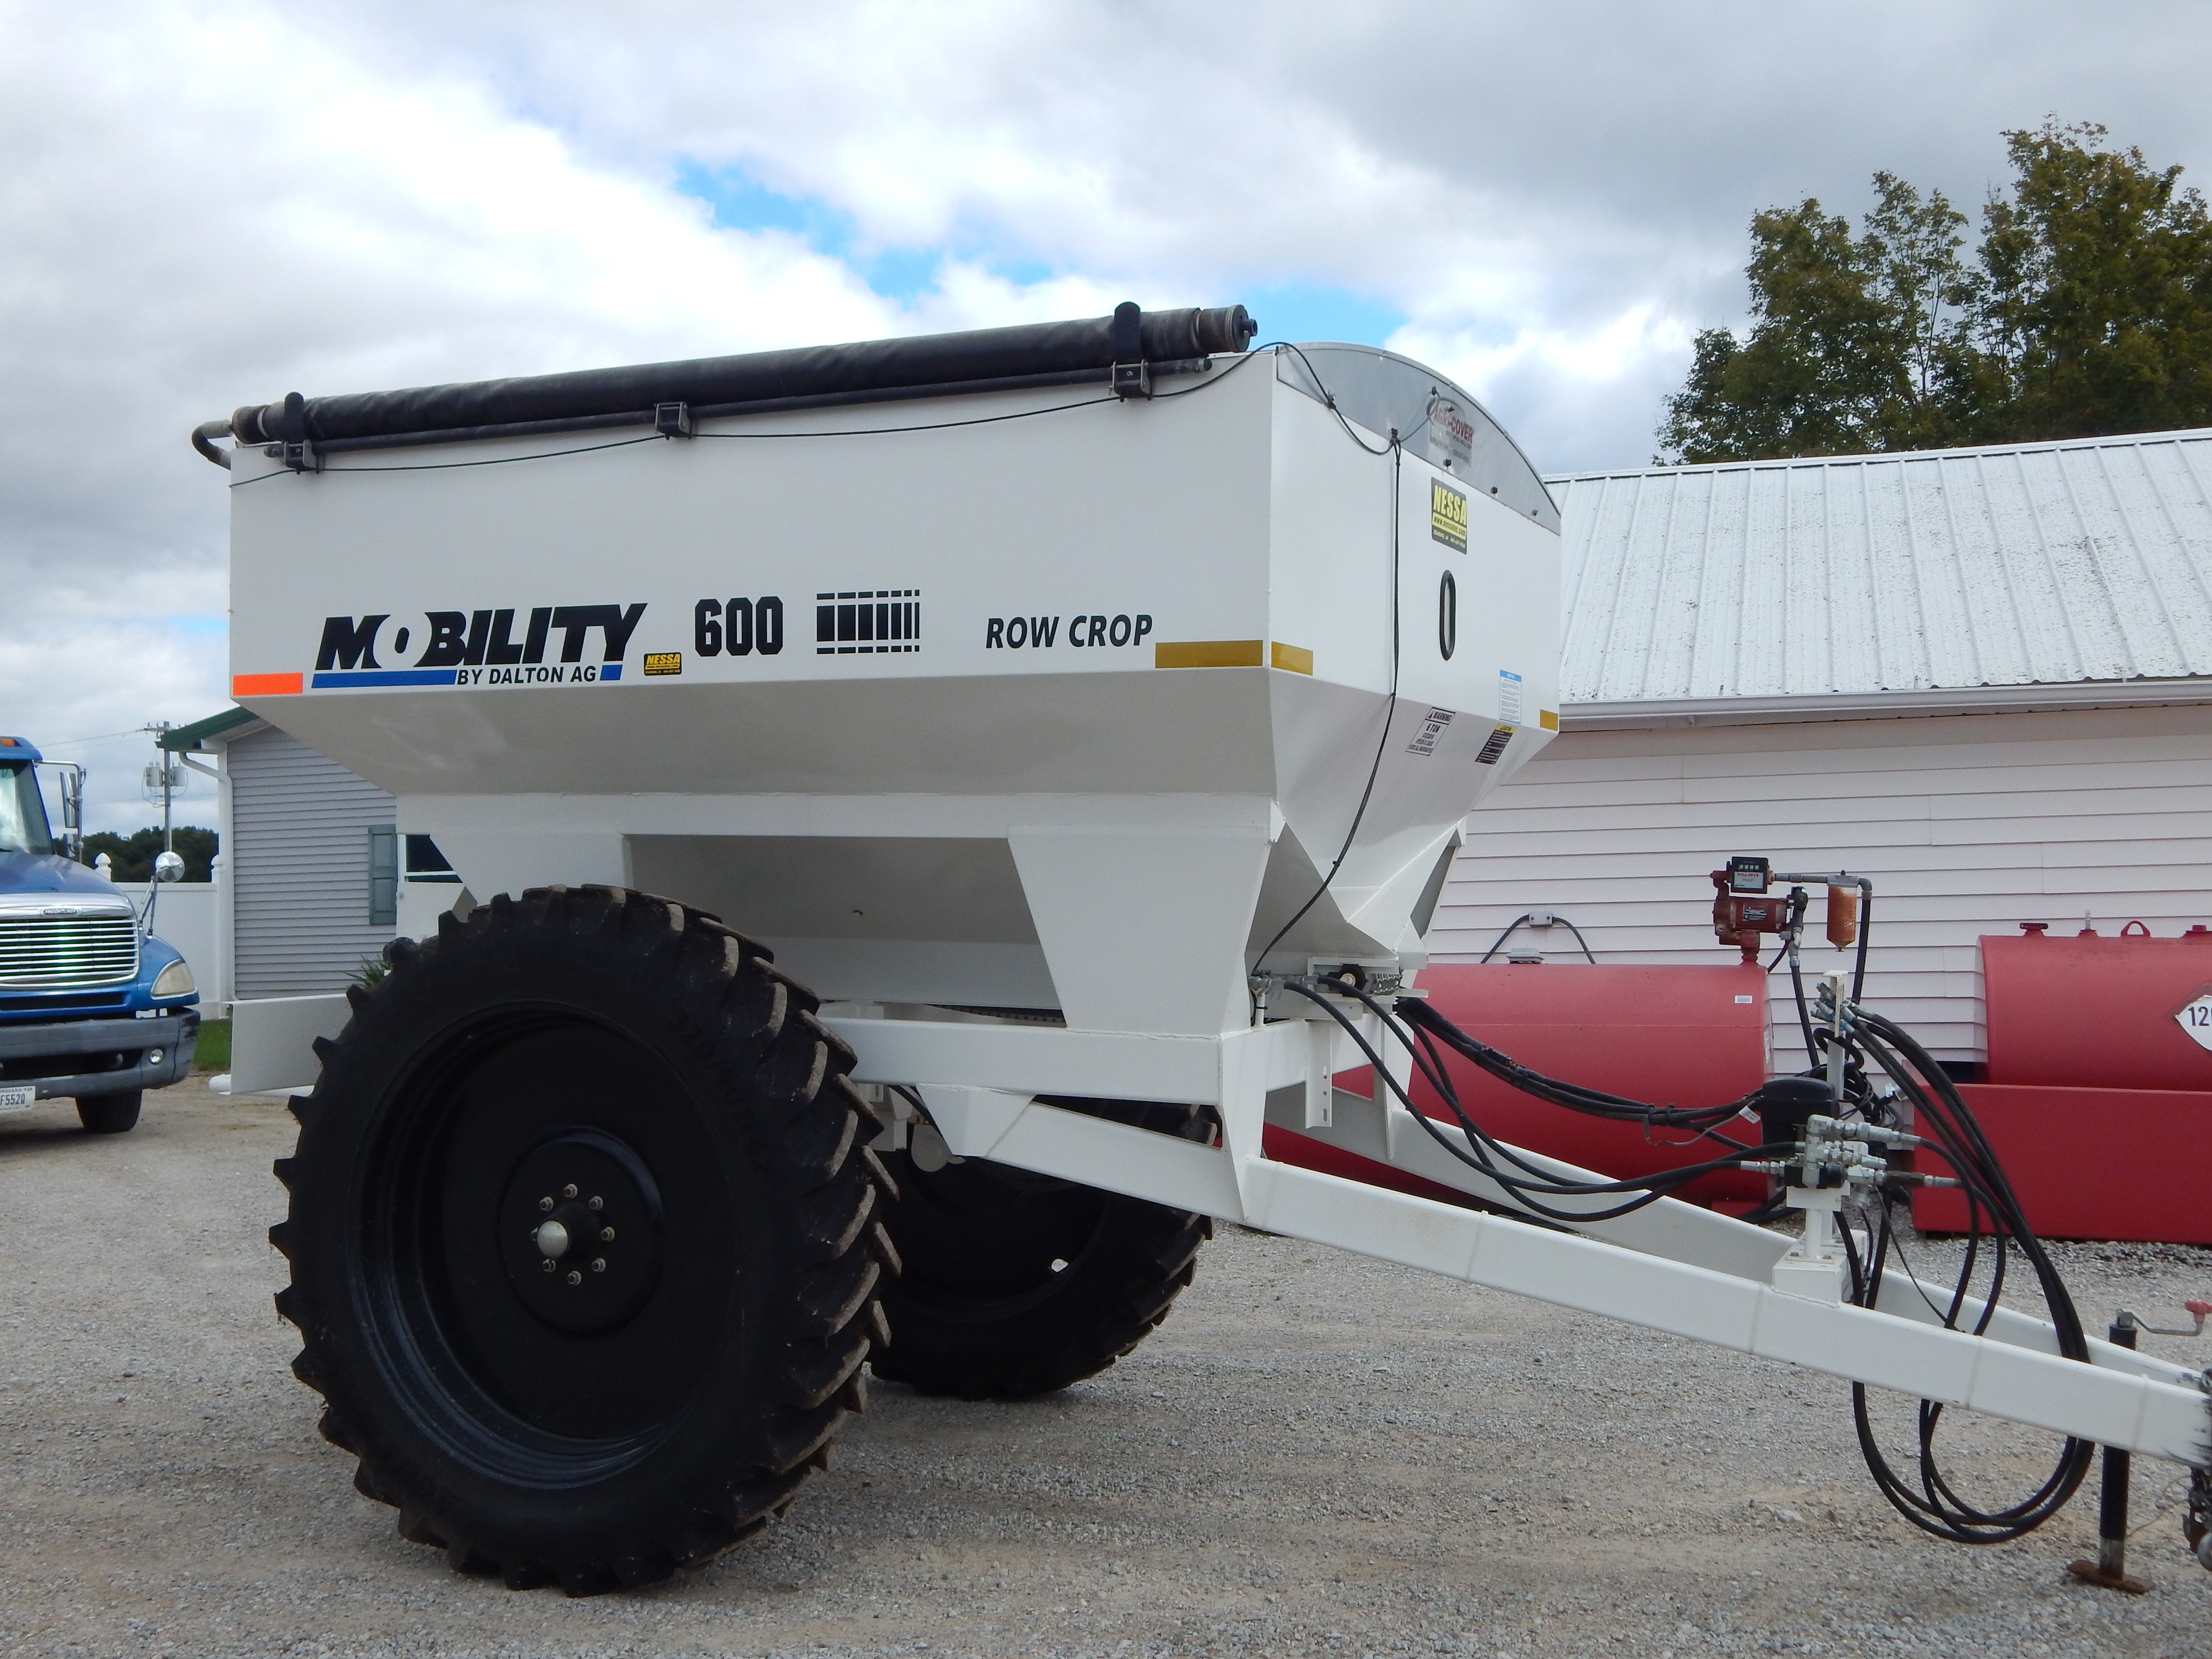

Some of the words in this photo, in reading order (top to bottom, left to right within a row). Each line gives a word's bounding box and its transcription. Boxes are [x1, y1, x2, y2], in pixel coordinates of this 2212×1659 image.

[1433, 485, 1467, 525] NESSA
[315, 603, 648, 670] MOBILITY
[695, 596, 783, 657] 600
[986, 616, 1059, 648] ROW
[1068, 614, 1153, 647] CROP
[457, 669, 483, 685] BY
[489, 667, 564, 684] DALTON
[570, 665, 597, 682] AG
[647, 653, 680, 664] NESSA
[2188, 1006, 2212, 1026] 12
